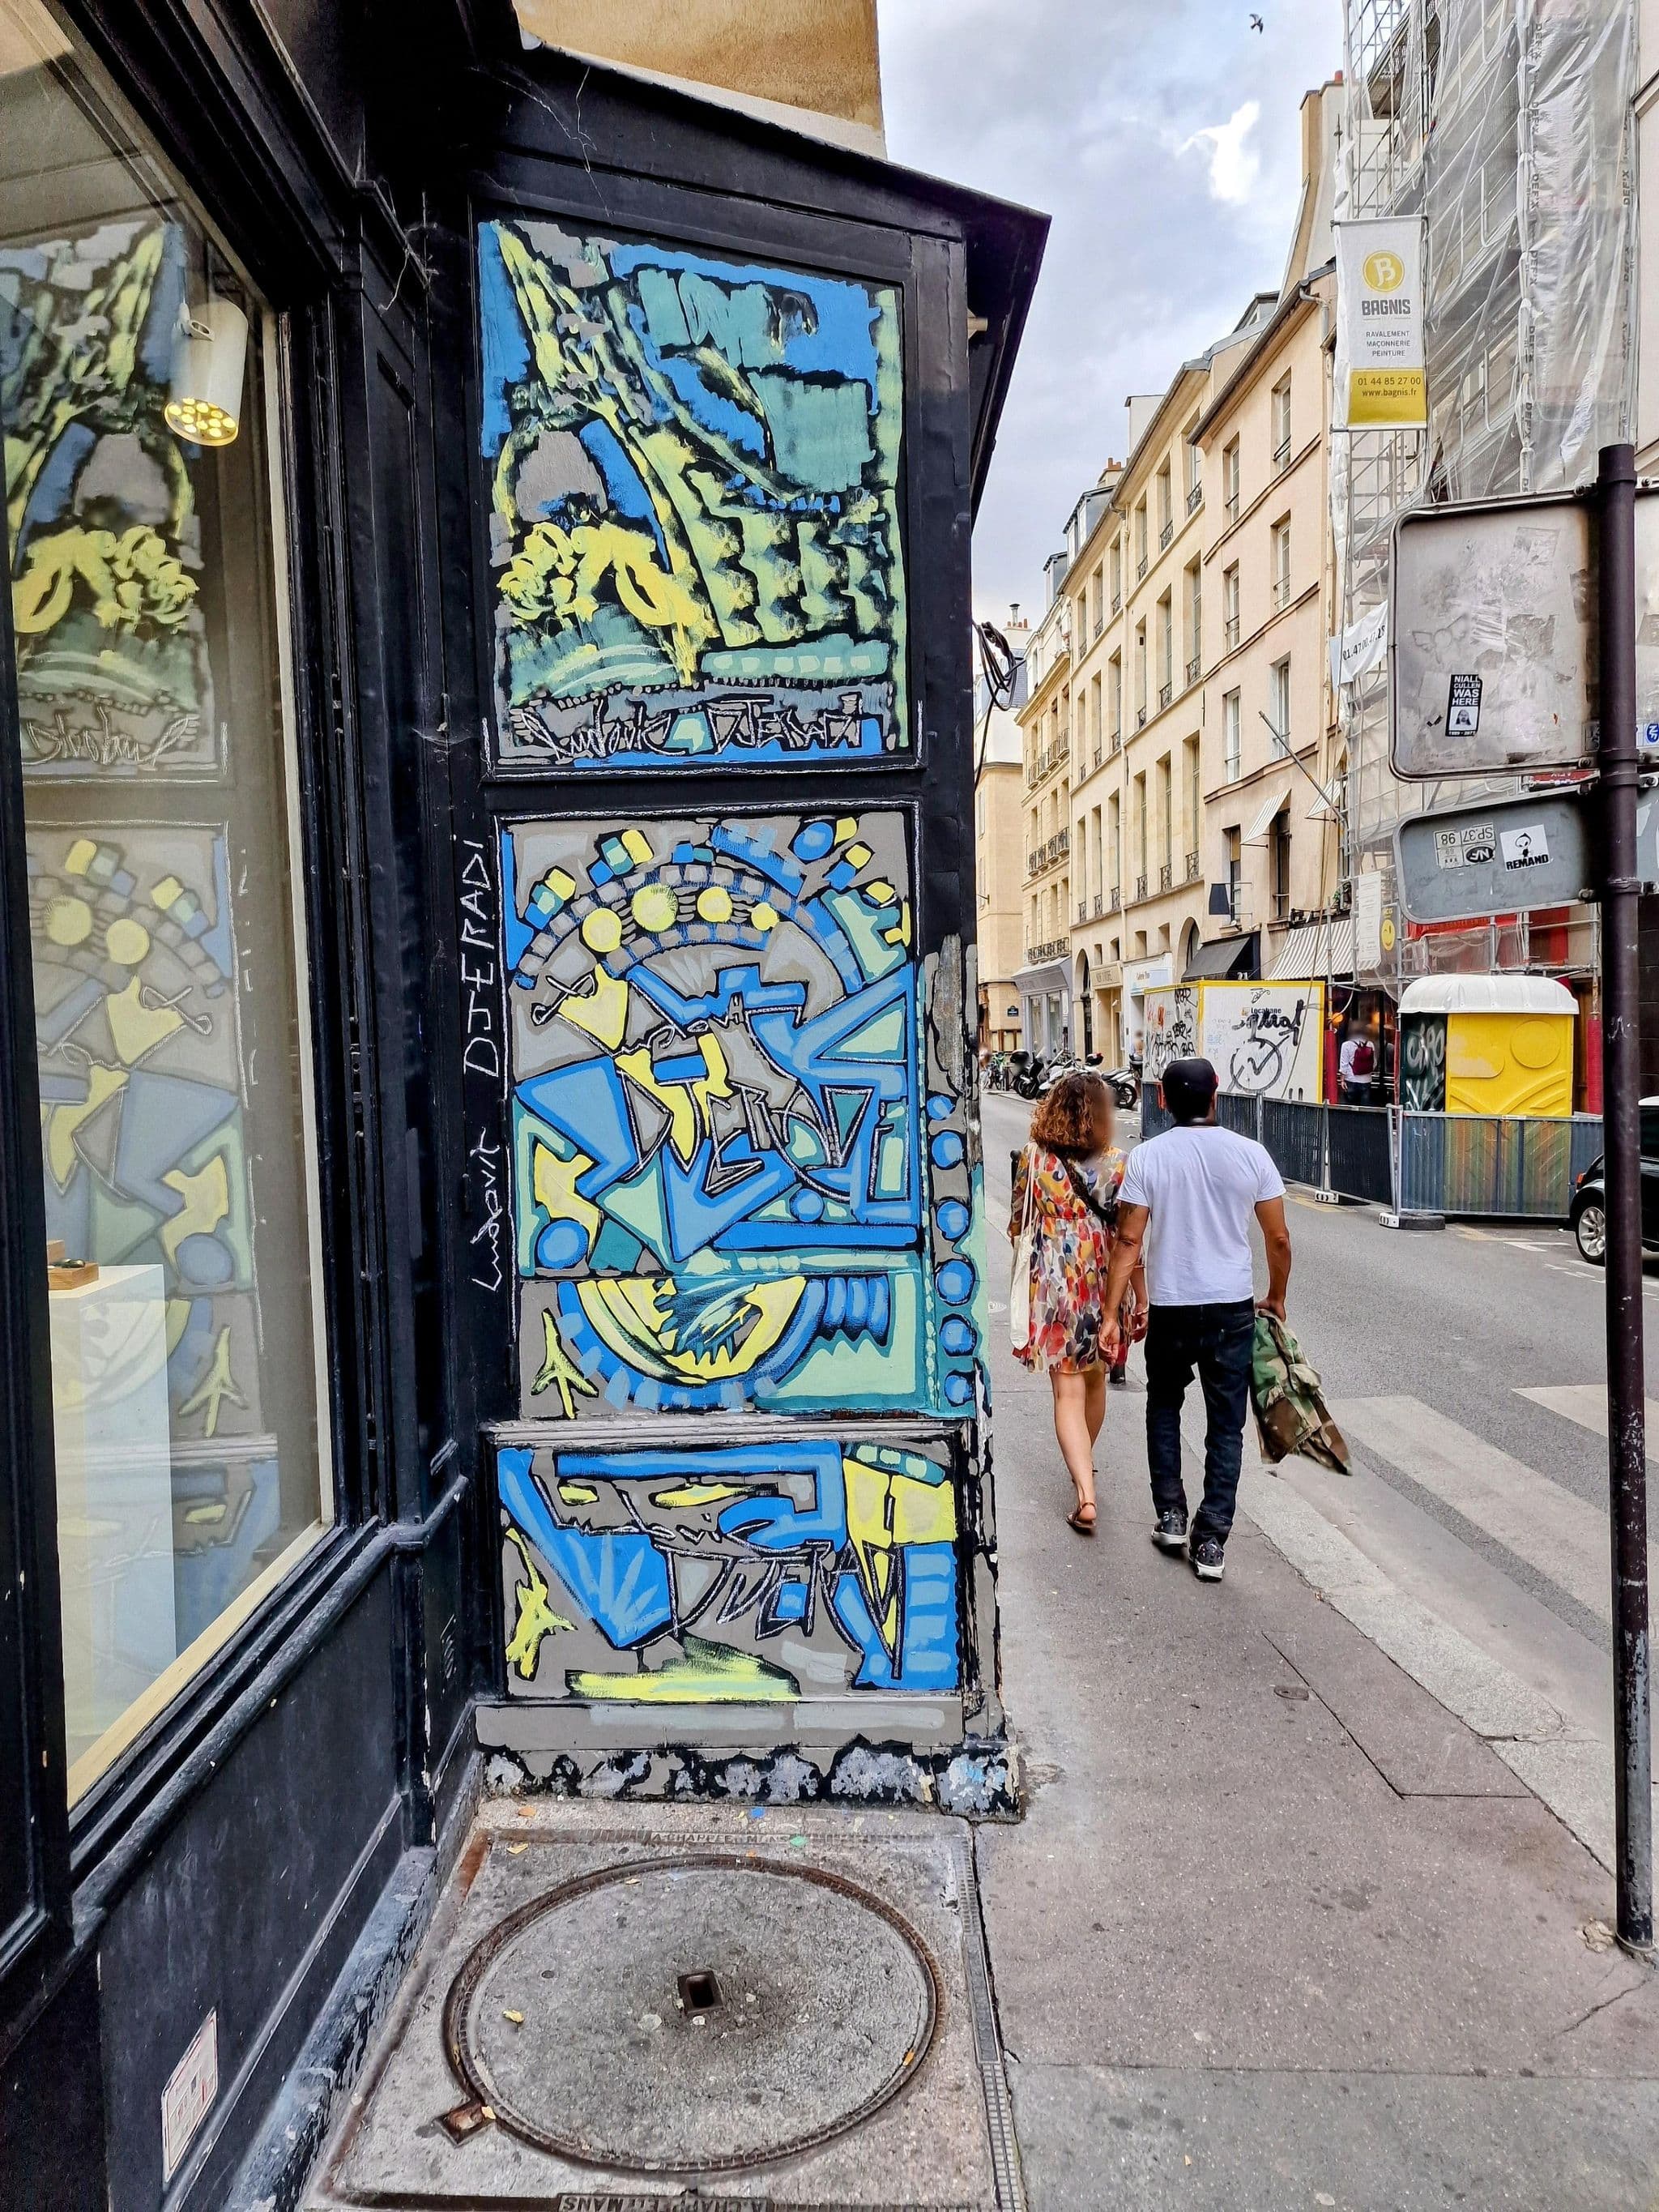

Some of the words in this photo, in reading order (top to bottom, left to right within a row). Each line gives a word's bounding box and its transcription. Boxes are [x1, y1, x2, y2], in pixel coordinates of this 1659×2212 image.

[1361, 298, 1411, 316] BAGNIS
[1366, 330, 1410, 338] RAVALEMENT
[1366, 340, 1411, 348] MAÇONNERIE
[1358, 378, 1368, 386] 01
[1371, 378, 1382, 386] 44
[1384, 377, 1395, 386] 85
[1397, 377, 1408, 385] 27
[1410, 377, 1422, 385] 00
[1362, 387, 1417, 398] www.bagnis.fr
[1454, 675, 1481, 683] NIALL
[1453, 689, 1480, 698] WAS
[1452, 698, 1479, 706] HERE
[1440, 832, 1456, 845] 98
[1463, 826, 1494, 843] SP.37
[1469, 848, 1491, 860] NF
[1506, 853, 1549, 870] REMAND
